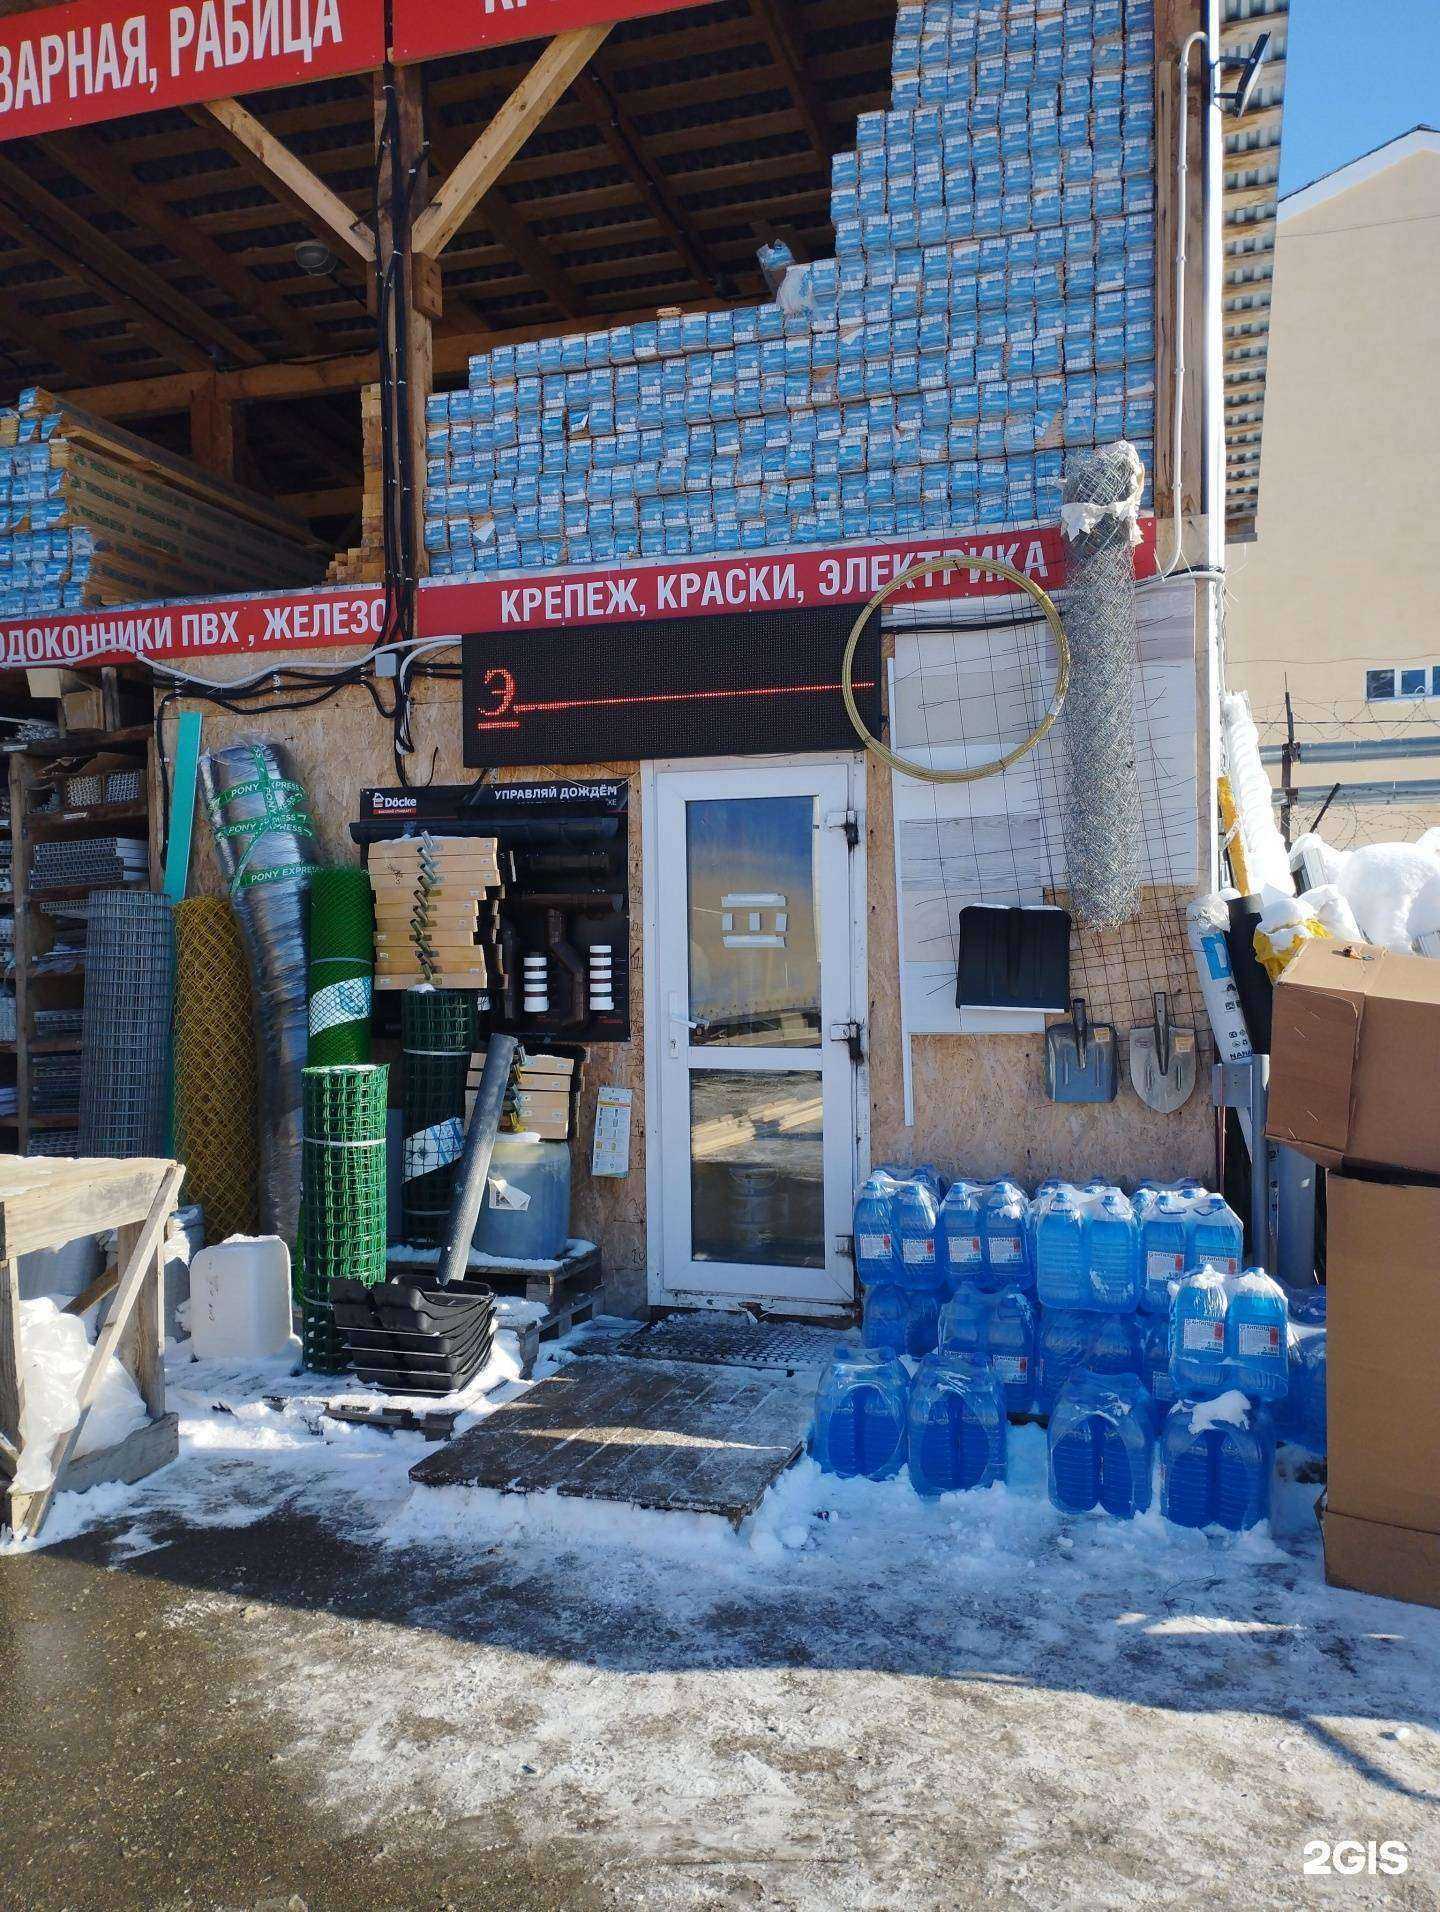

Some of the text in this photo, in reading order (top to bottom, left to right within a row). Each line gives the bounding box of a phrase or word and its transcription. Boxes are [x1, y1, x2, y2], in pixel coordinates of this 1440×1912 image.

[170, 0, 343, 77] РАБИЦА
[501, 541, 1049, 623] КРЕПЕЖ, КРАСКИ, ЭЛЕКТРИКА
[0, 616, 172, 664] ДОКОННИКИ
[182, 604, 239, 645] ПВХ
[263, 598, 386, 641] ЖЕЛЕЗО
[231, 783, 259, 798] PONY
[494, 784, 617, 800] УПРАВЛЯЙ ДОЖДЁМ
[384, 797, 417, 808] Döcke
[251, 870, 279, 883] PONY
